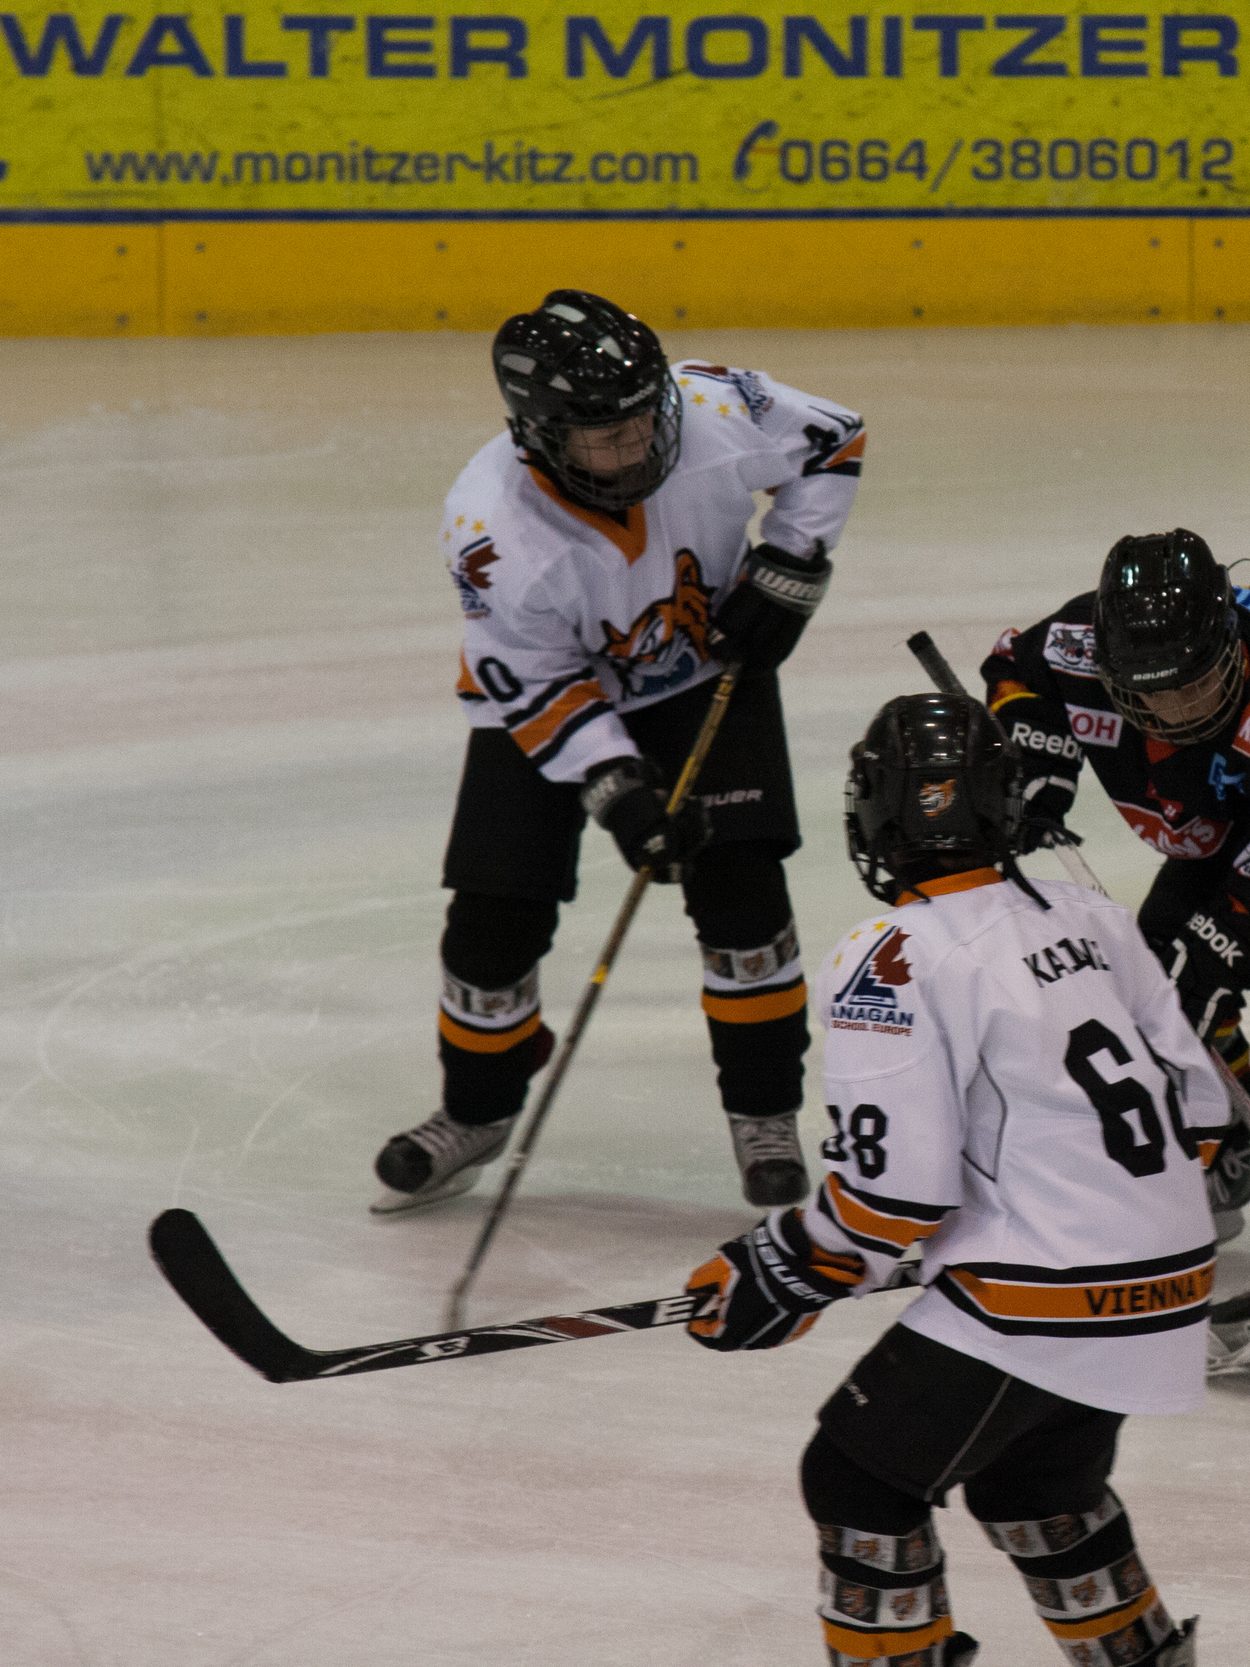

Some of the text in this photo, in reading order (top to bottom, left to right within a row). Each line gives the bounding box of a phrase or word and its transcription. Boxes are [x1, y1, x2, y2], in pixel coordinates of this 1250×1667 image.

[0, 13, 1239, 79] WALTER MONITZER
[84, 138, 1235, 193] www.monitzer-kitz.com 0664/3806012
[1132, 667, 1179, 681] BAUER
